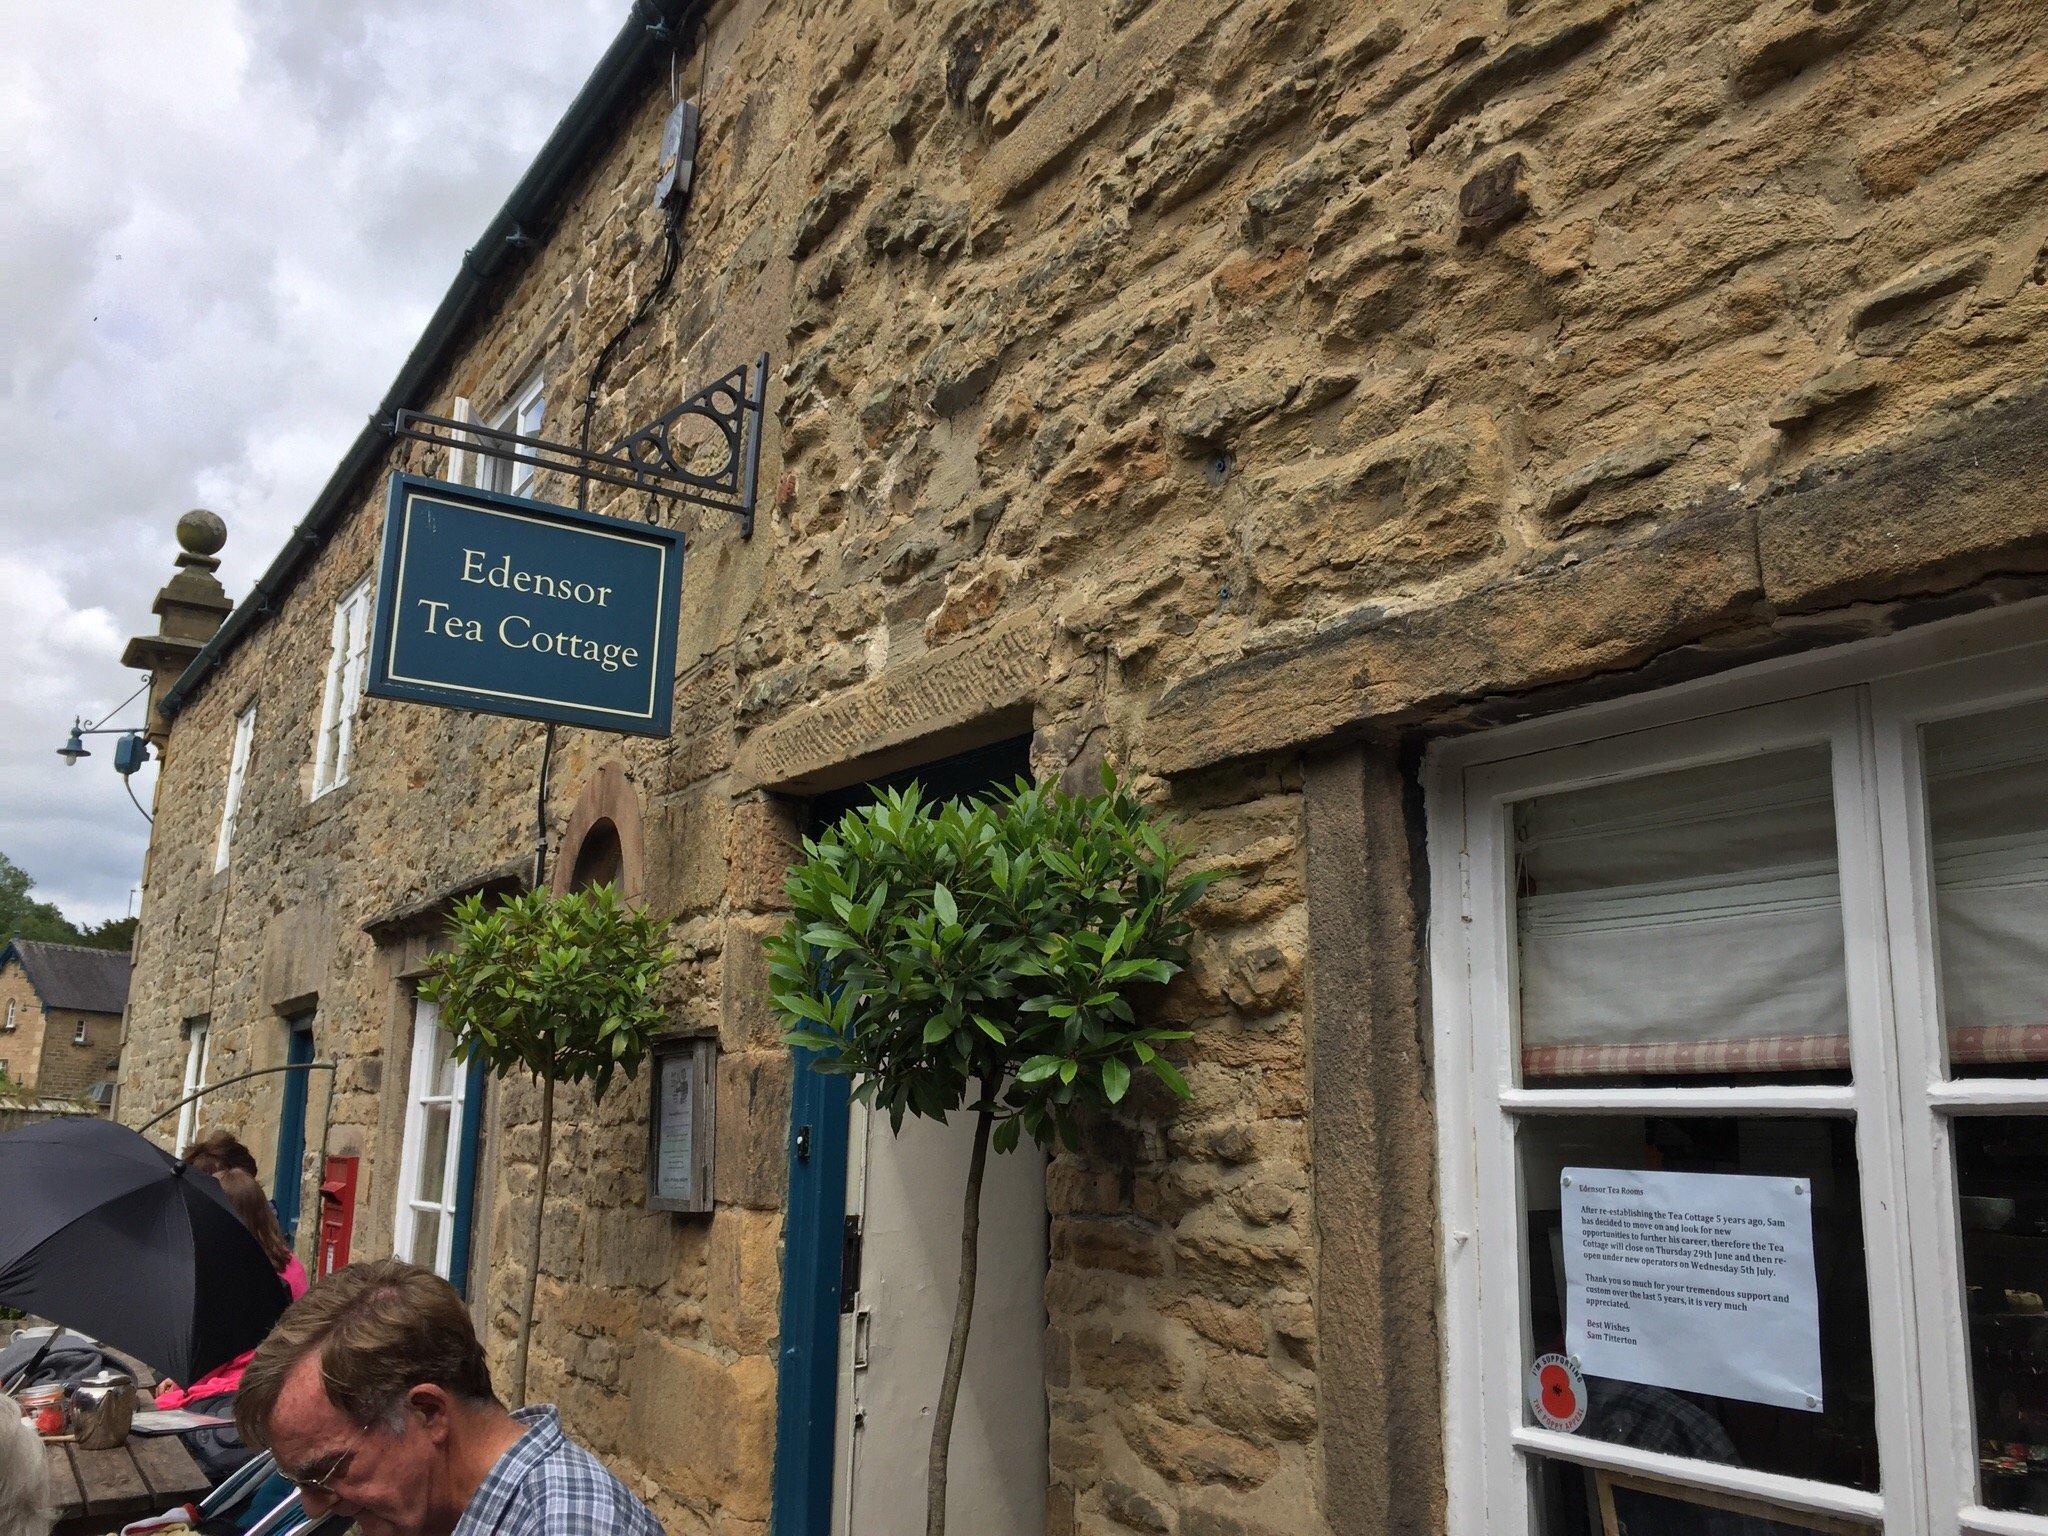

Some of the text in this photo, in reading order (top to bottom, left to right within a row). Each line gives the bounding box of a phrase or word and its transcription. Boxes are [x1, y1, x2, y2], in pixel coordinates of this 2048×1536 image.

[460, 548, 612, 607] Edensor
[418, 599, 638, 672] Tea Cottage
[1579, 1184, 1644, 1196] Edensor Tea Rooms
[1581, 1205, 1785, 1227] After re-establishing the Tea Cottage 5 years ago, Sam
[1581, 1216, 1594, 1226] has
[1595, 1218, 1622, 1228] decided
[1623, 1220, 1631, 1228] to
[1632, 1221, 1653, 1229] move
[1665, 1224, 1680, 1232] and
[1681, 1224, 1699, 1233] look
[1700, 1225, 1712, 1234] for
[1582, 1229, 1784, 1252] opportunities to further his career, therefore the Tea
[1582, 1239, 1609, 1250] Cottage
[1610, 1242, 1624, 1250] will
[1625, 1243, 1644, 1252] close
[1656, 1245, 1691, 1259] Thursday
[1693, 1249, 1712, 1258] 29th
[1714, 1251, 1733, 1260] June
[1734, 1253, 1751, 1262] and
[1752, 1254, 1772, 1263] then
[1774, 1257, 1787, 1265] re-
[1583, 1252, 1601, 1260] open
[1602, 1253, 1623, 1262] under
[1624, 1256, 1640, 1264] new
[1641, 1258, 1678, 1267] operators
[1691, 1261, 1738, 1275] Wednesday
[1740, 1265, 1755, 1275] 5th
[1756, 1267, 1776, 1278] July.
[1585, 1273, 1608, 1283] Thank
[1608, 1277, 1621, 1285] you
[1632, 1279, 1653, 1288] much
[1653, 1281, 1665, 1290] for
[1666, 1284, 1684, 1293] your
[1686, 1285, 1735, 1298] tremendous
[1736, 1292, 1771, 1302] support
[1772, 1294, 1790, 1303] and
[1585, 1286, 1748, 1311] custom over the last 5 years, it is very much
[1586, 1297, 1630, 1309] appreciated.
[1587, 1319, 1630, 1333] Best Wishes
[1587, 1331, 1637, 1345] Sam Titterton
[1541, 1355, 1583, 1383] SUPPORTING
[1533, 1399, 1585, 1430] THE POPPY APPEAL
